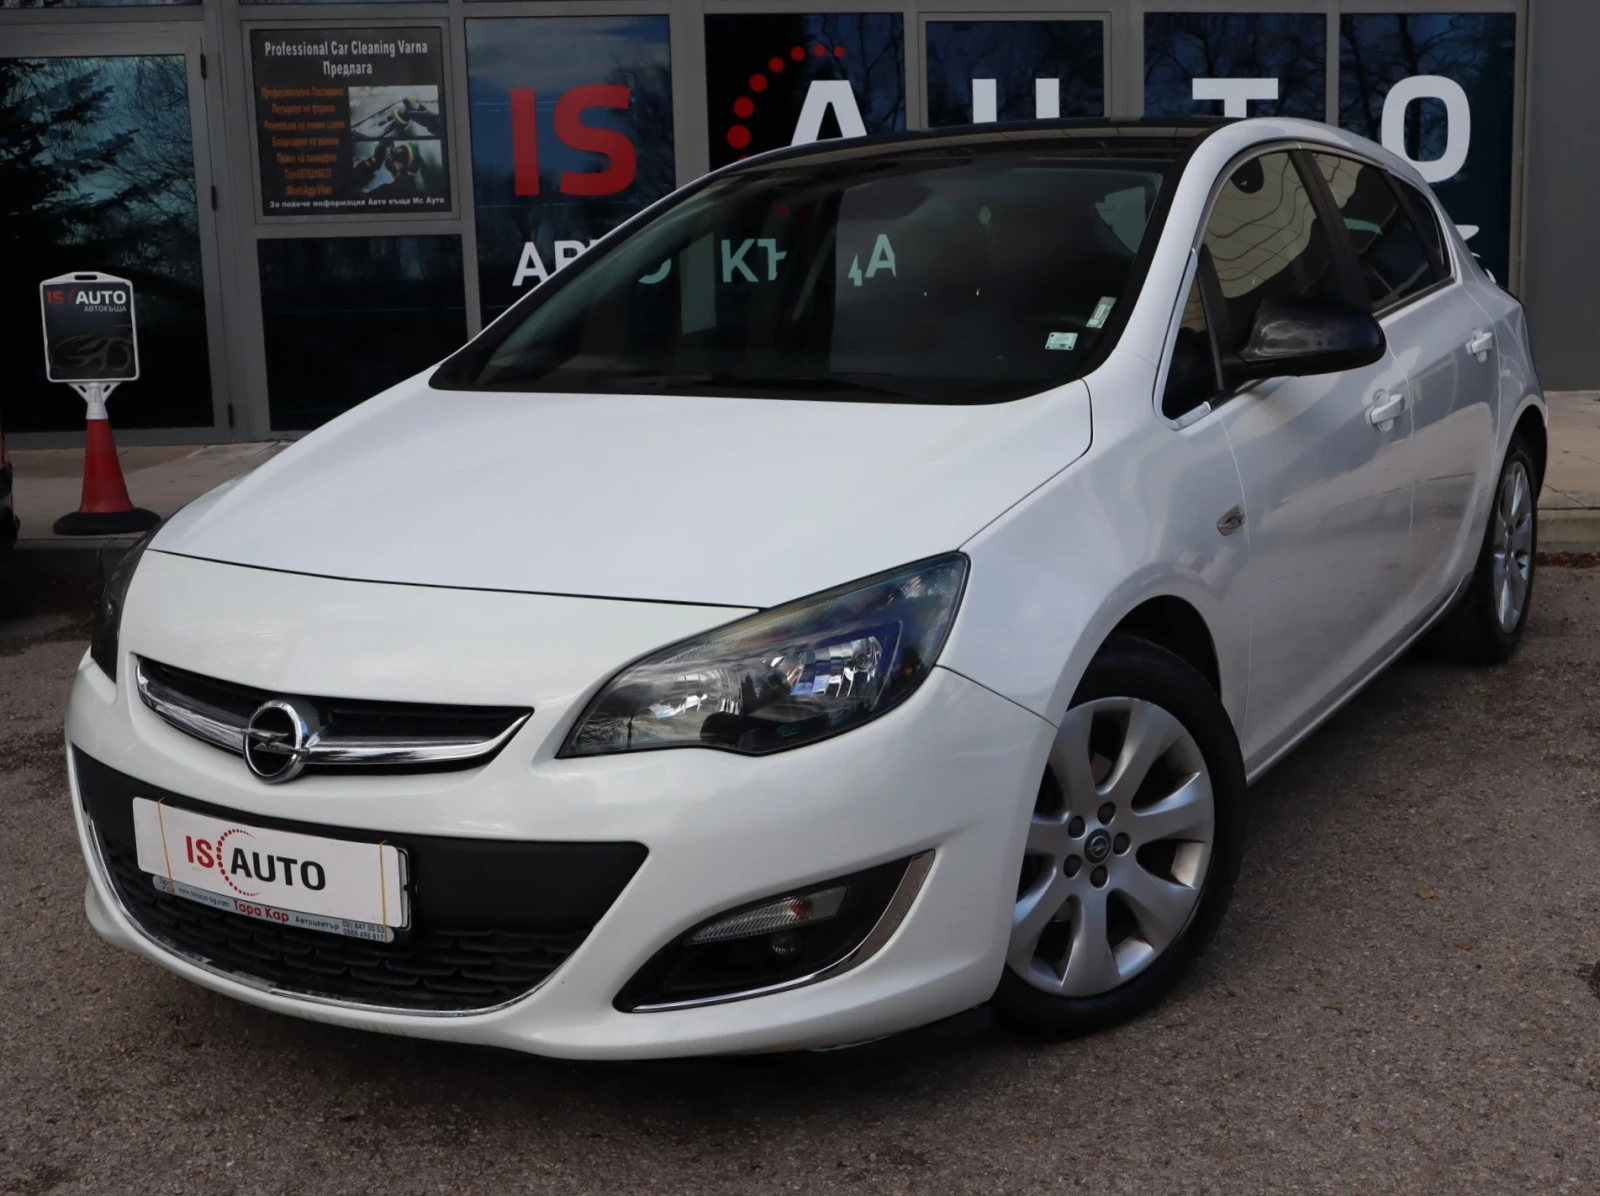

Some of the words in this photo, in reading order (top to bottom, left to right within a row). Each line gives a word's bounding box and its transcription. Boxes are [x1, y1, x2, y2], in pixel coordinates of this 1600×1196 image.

[265, 41, 328, 56] Professional
[331, 41, 349, 55] Car
[351, 40, 396, 58] Cleaning
[398, 39, 428, 54] Varna
[323, 61, 373, 78] Предлага
[509, 84, 638, 197] IS
[269, 200, 280, 208] За
[282, 201, 311, 209] повече
[313, 199, 366, 209] информация
[388, 199, 411, 207] къща
[426, 196, 445, 205] Ауто
[47, 290, 65, 304] IS
[75, 290, 127, 305] AUTO
[186, 835, 214, 869] IS
[230, 847, 326, 891] AUTO
[233, 899, 262, 918] Тара
[264, 907, 290, 923] Кар
[295, 915, 339, 931] Автоцентър
